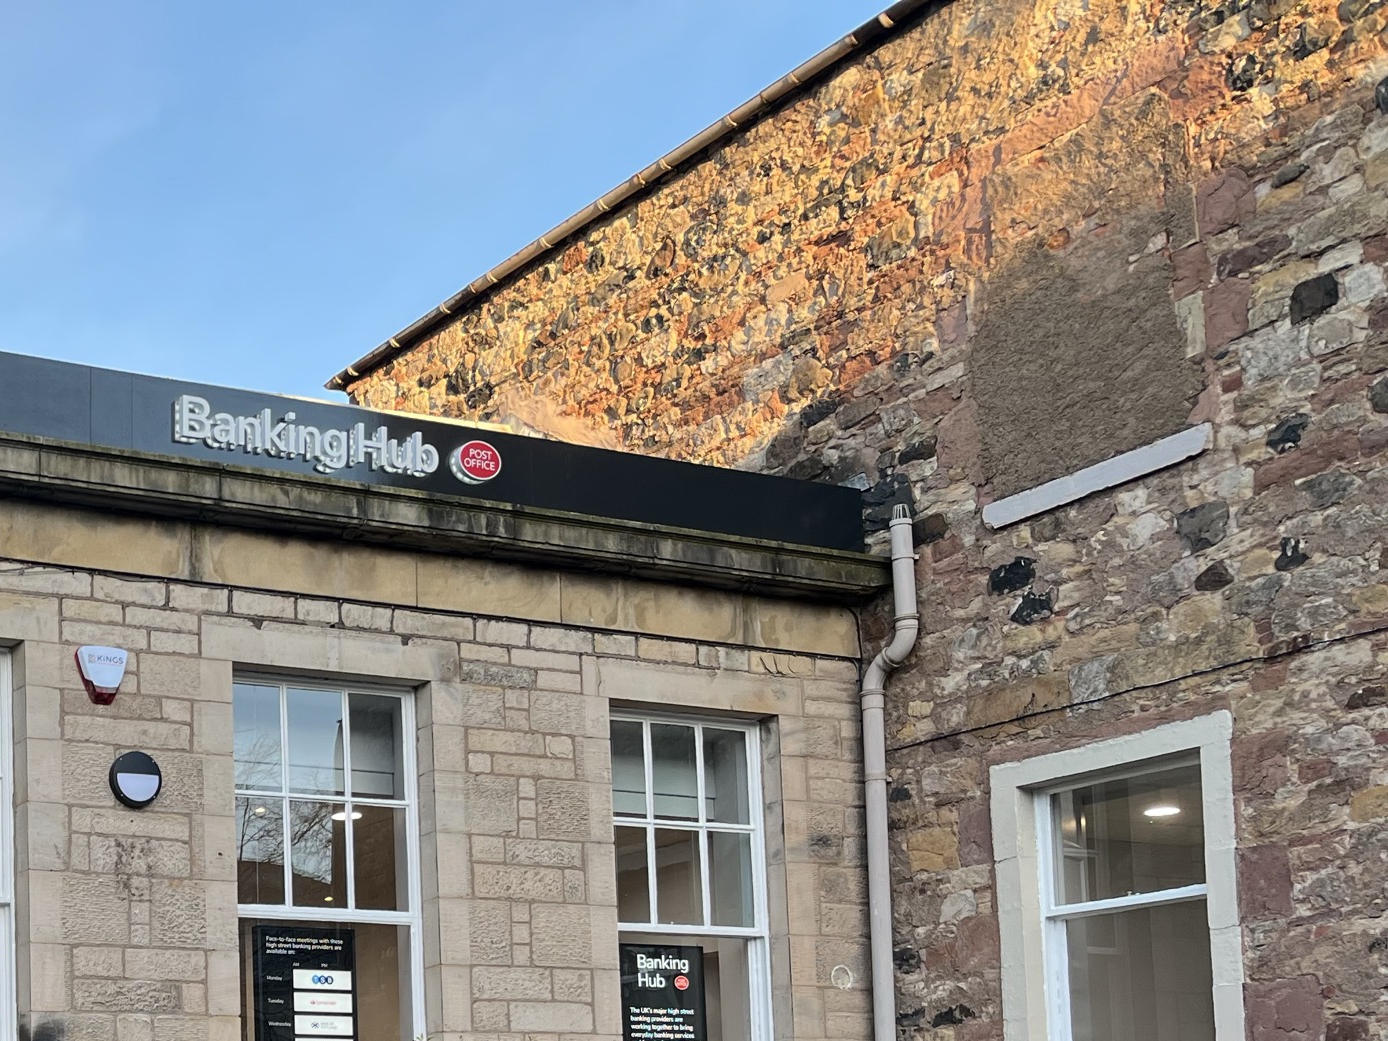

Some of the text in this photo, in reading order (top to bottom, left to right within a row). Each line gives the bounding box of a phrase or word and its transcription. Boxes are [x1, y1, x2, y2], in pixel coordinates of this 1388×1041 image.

[469, 448, 492, 460] POST
[464, 458, 496, 471] OFFICE
[97, 655, 124, 665] KINGS
[637, 954, 689, 973] Banking
[638, 972, 665, 988] Hub
